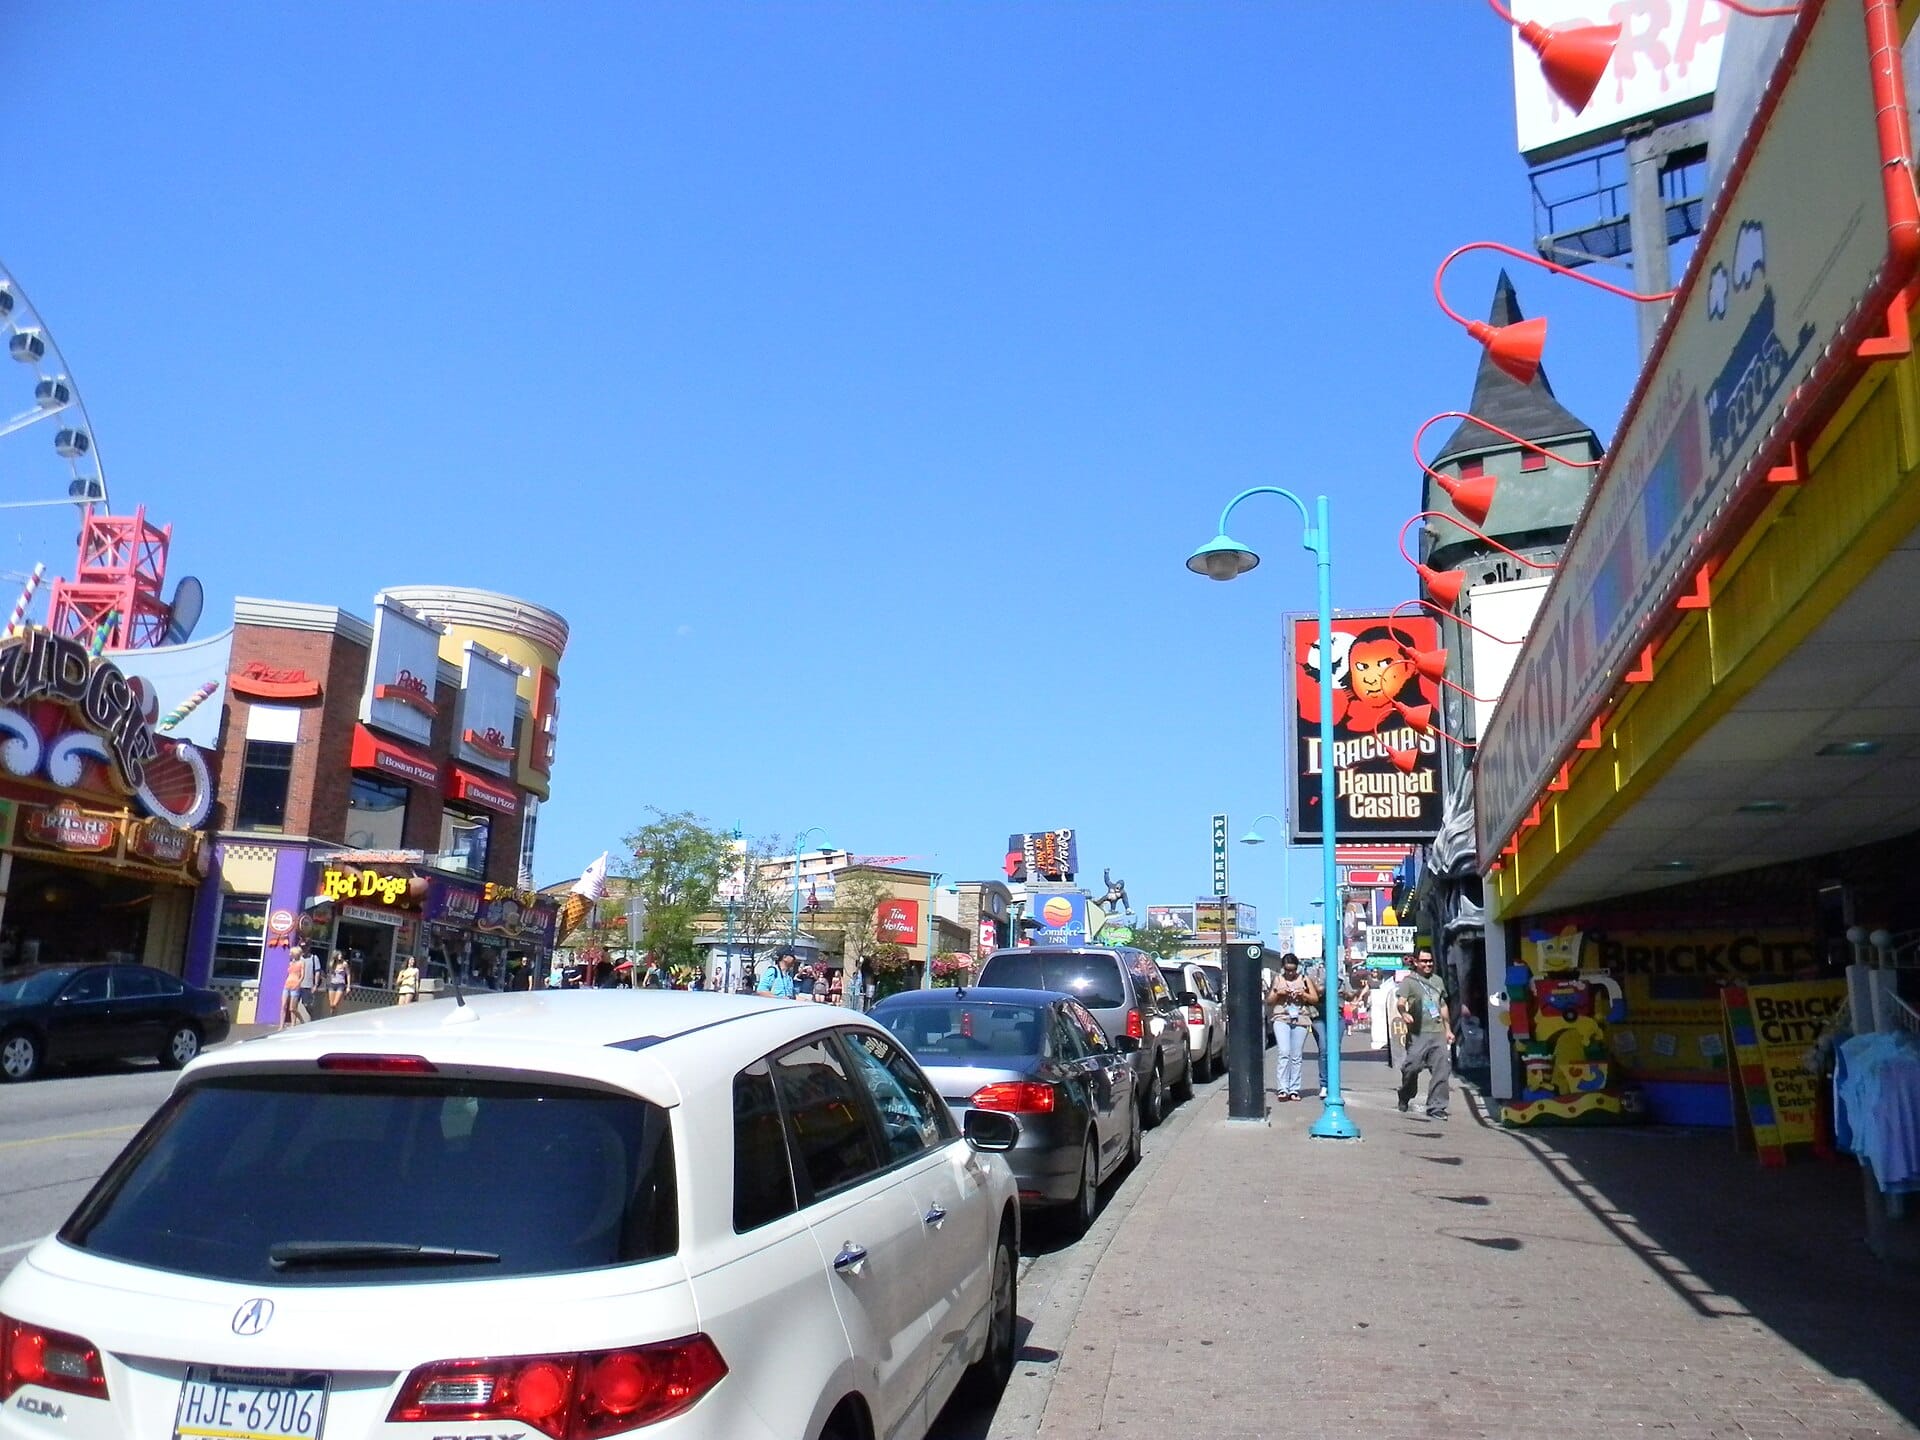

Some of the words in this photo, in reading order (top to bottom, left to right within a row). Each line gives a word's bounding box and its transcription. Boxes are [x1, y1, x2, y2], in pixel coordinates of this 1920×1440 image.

[385, 755, 415, 774] Boston
[414, 767, 435, 782] Pizza
[1338, 768, 1434, 796] Haunted
[473, 787, 497, 803] Boston
[497, 798, 516, 811] Pizza
[1350, 793, 1421, 819] Castle
[1215, 819, 1224, 848] PAY
[1215, 852, 1225, 891] HERE
[324, 870, 358, 900] Hot
[360, 870, 407, 904] Dogs
[881, 918, 915, 934] Hortons
[890, 907, 907, 921] Tim
[1037, 923, 1080, 937] Comfort
[1049, 936, 1067, 944] INN
[1761, 1021, 1824, 1044] CITY
[16, 1395, 65, 1419] ACURA
